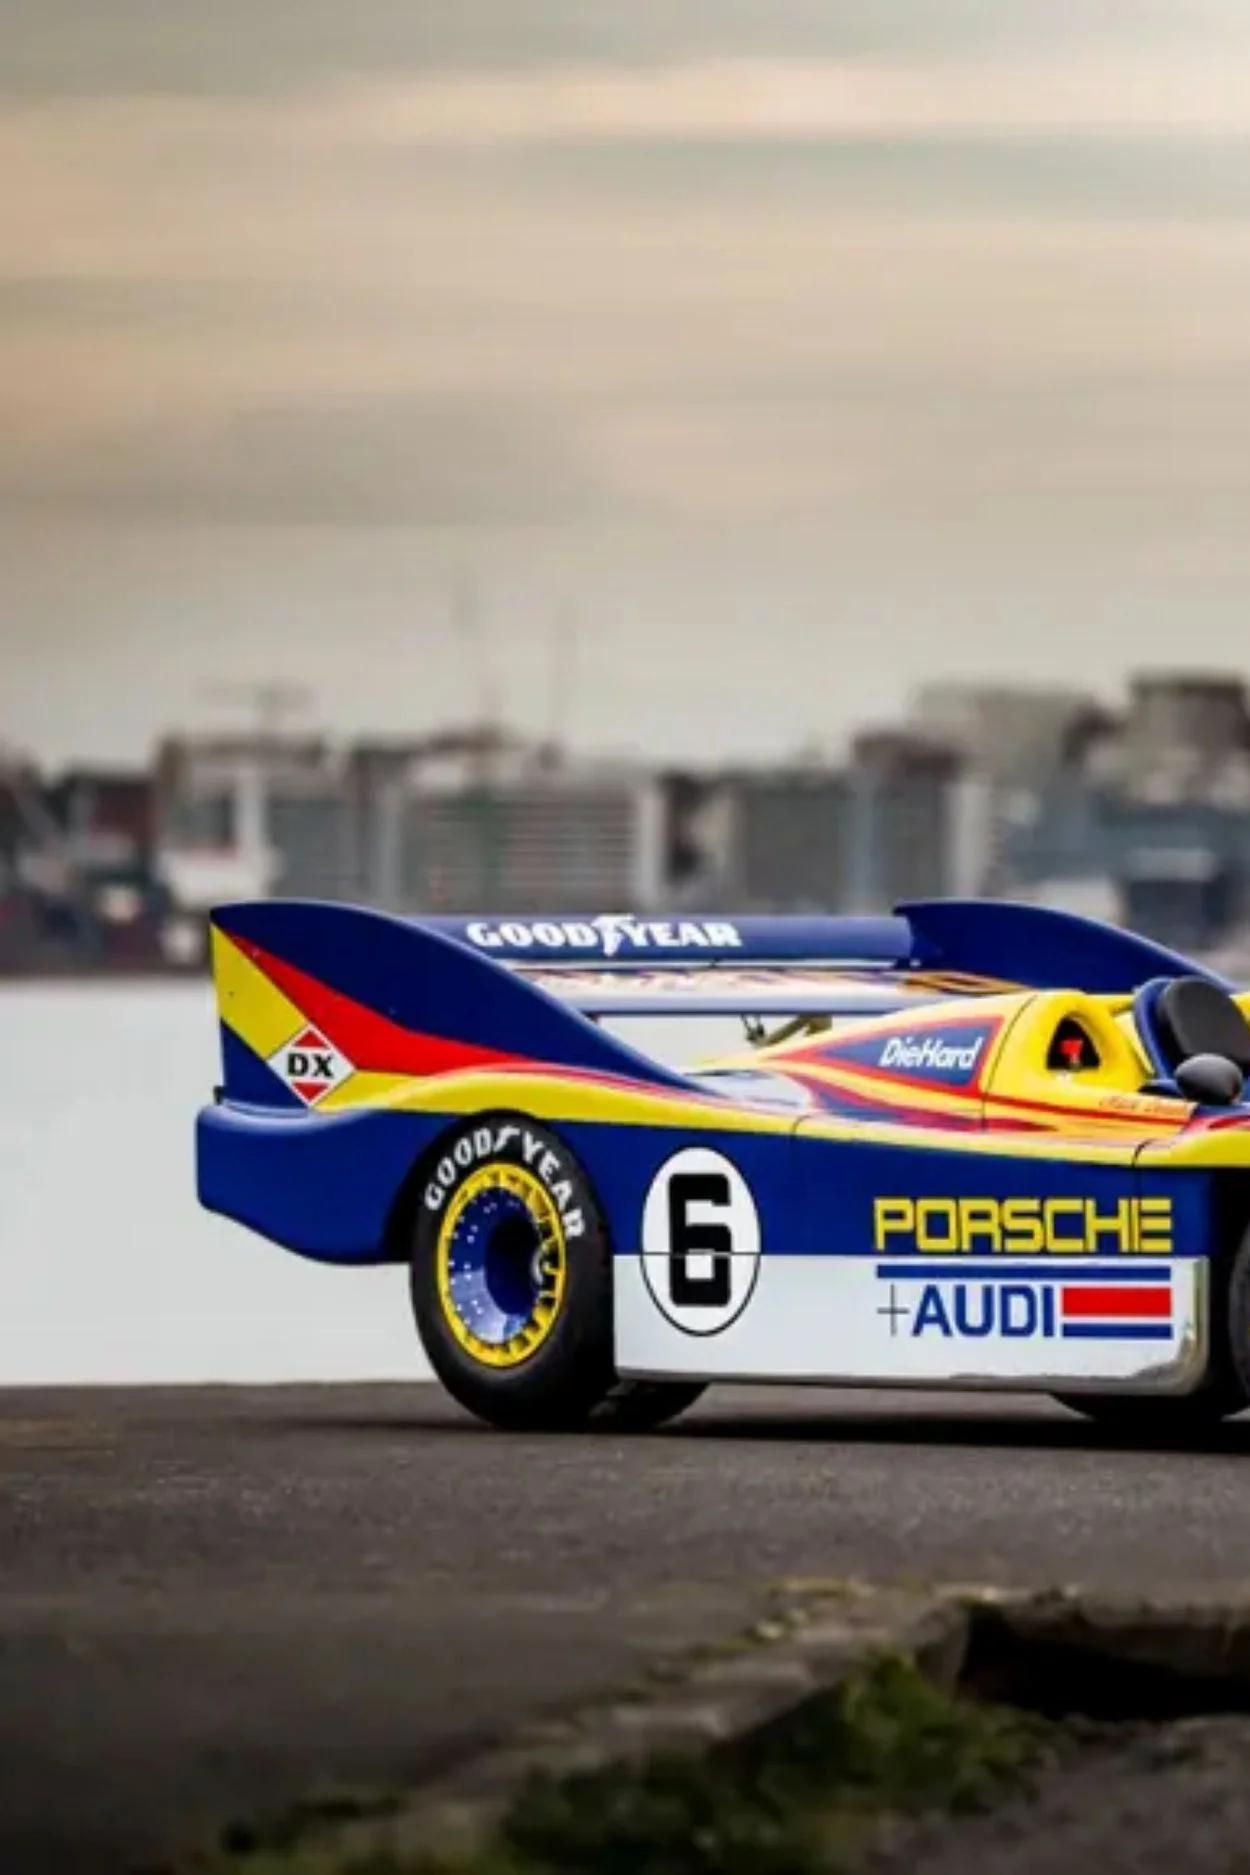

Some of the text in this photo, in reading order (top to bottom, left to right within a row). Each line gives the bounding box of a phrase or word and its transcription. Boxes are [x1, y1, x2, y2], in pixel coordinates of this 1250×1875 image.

[466, 915, 742, 956] GOODYEAR
[288, 1053, 333, 1078] DX
[879, 1036, 984, 1070] DieHard
[424, 1125, 586, 1239] GOODYEAR
[668, 1173, 732, 1307] 6
[873, 1197, 1173, 1253] PORSCHE
